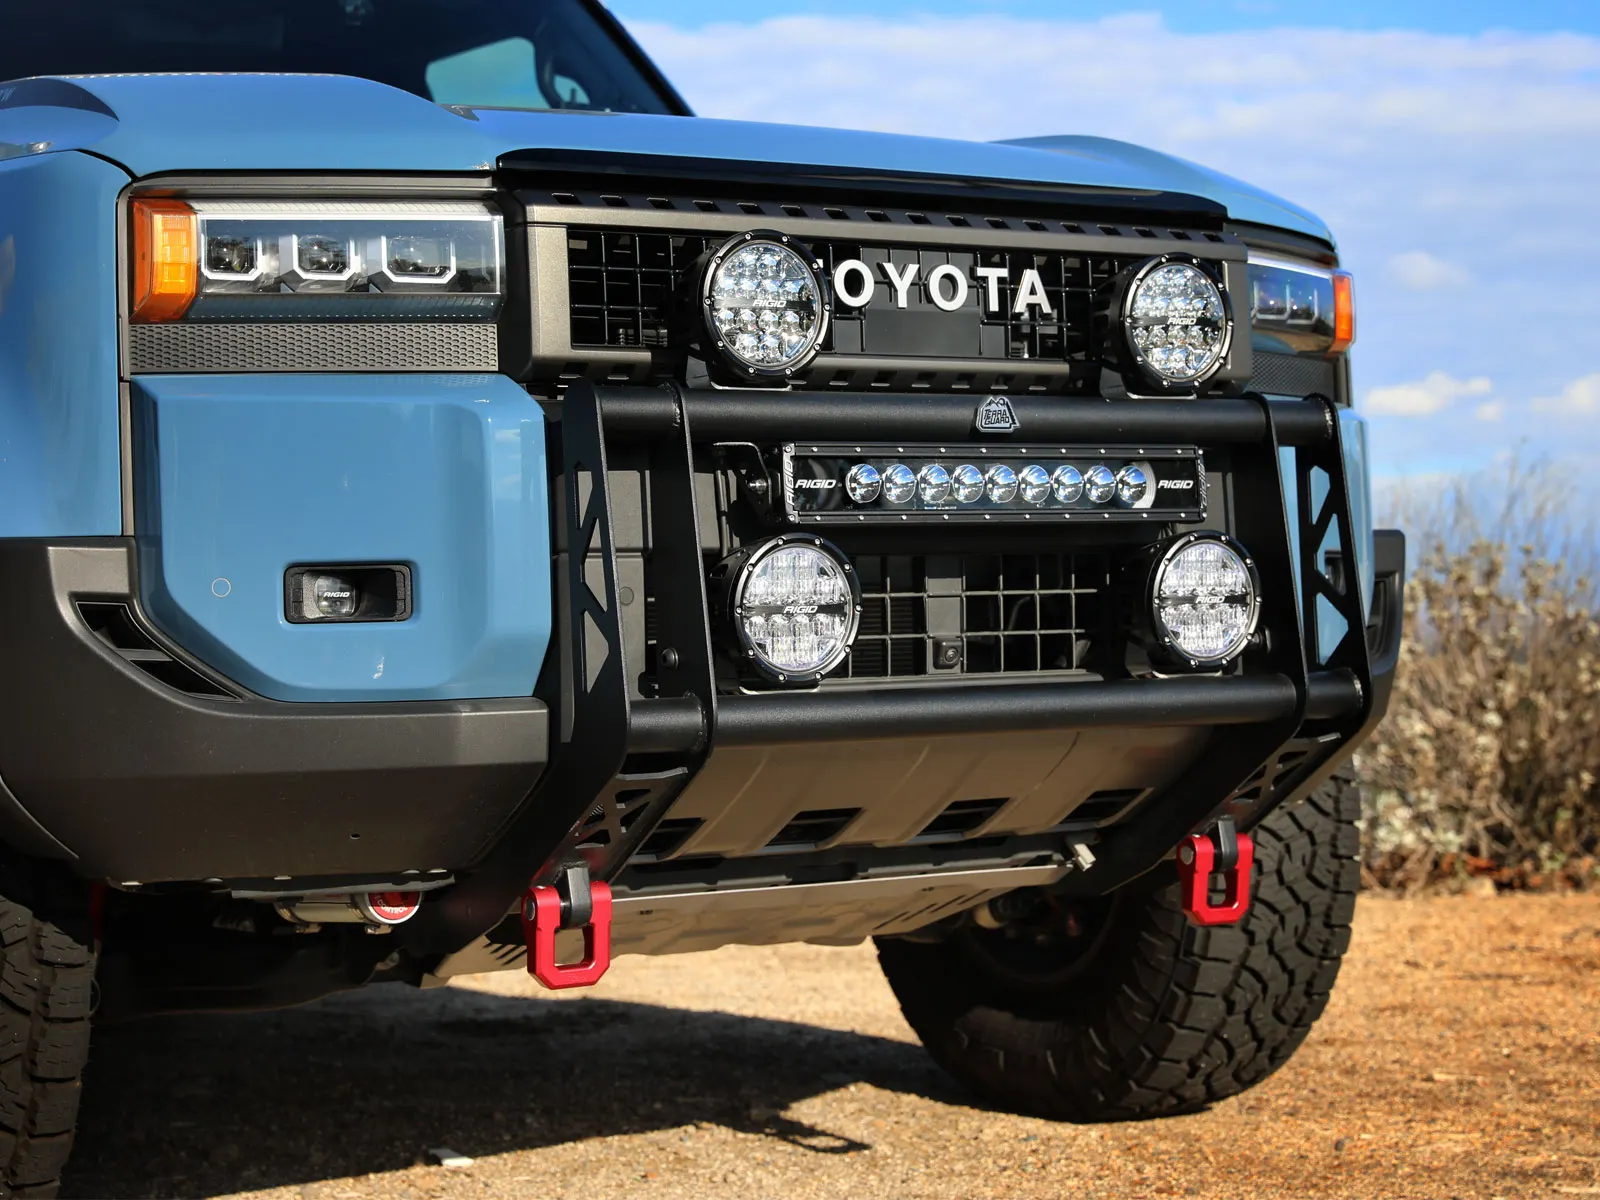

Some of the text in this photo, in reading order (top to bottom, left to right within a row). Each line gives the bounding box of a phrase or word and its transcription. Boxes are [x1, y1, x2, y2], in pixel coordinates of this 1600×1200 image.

[816, 258, 1052, 315] OYOTA
[752, 299, 787, 308] RIGID
[1167, 317, 1197, 325] RIGID
[984, 409, 1008, 419] TERRA
[984, 416, 1010, 425] GUARD
[784, 460, 795, 506] RIGID
[795, 479, 837, 489] RIGID
[1157, 479, 1194, 489] RIGID
[1195, 596, 1226, 604] RIGID
[783, 605, 818, 614] RIGID
